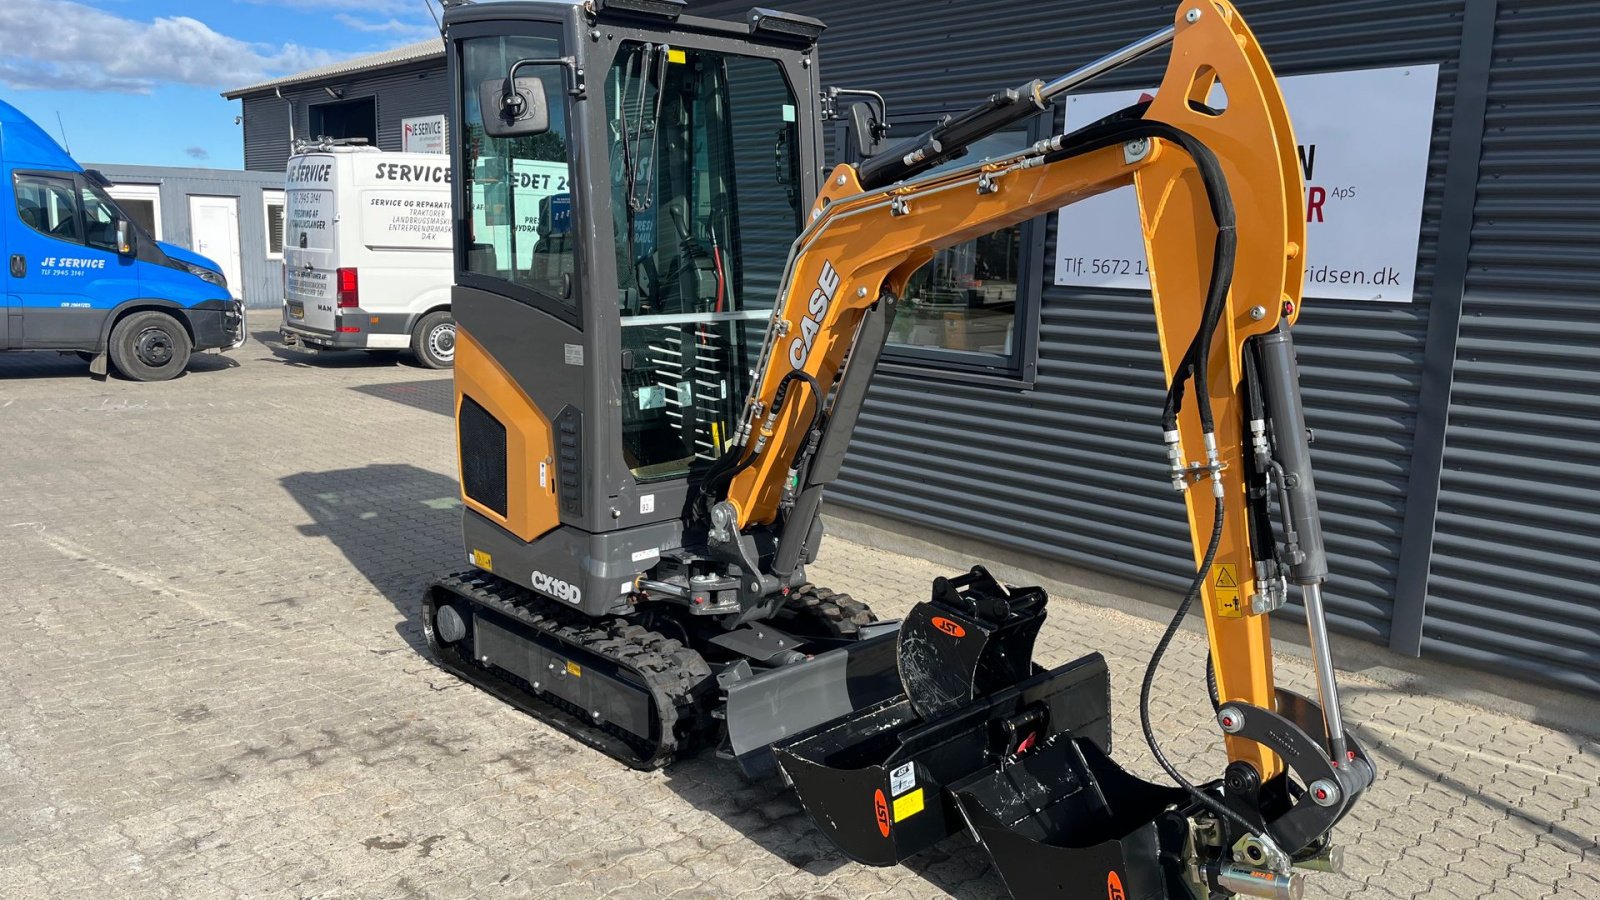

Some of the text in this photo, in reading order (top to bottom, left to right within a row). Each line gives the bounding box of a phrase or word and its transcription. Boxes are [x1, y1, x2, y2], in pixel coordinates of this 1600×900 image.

[419, 121, 441, 136] SERVICE
[296, 164, 332, 183] SERVICE
[375, 162, 452, 184] SERVICE
[1331, 186, 1356, 200] ApS
[370, 198, 402, 207] SERVICE
[409, 208, 446, 217] TRAKTORER
[388, 224, 453, 233] ENTREPRENØRMASK
[41, 257, 106, 269] JE SERVICE
[1064, 257, 1087, 277] Tlf.
[1092, 258, 1130, 275] 5672
[1304, 265, 1400, 286] ridsen.dk
[318, 304, 332, 312] MAN
[789, 259, 840, 370] CASE
[531, 570, 581, 604] CX19D
[939, 620, 958, 634] JST
[876, 800, 889, 827] JST
